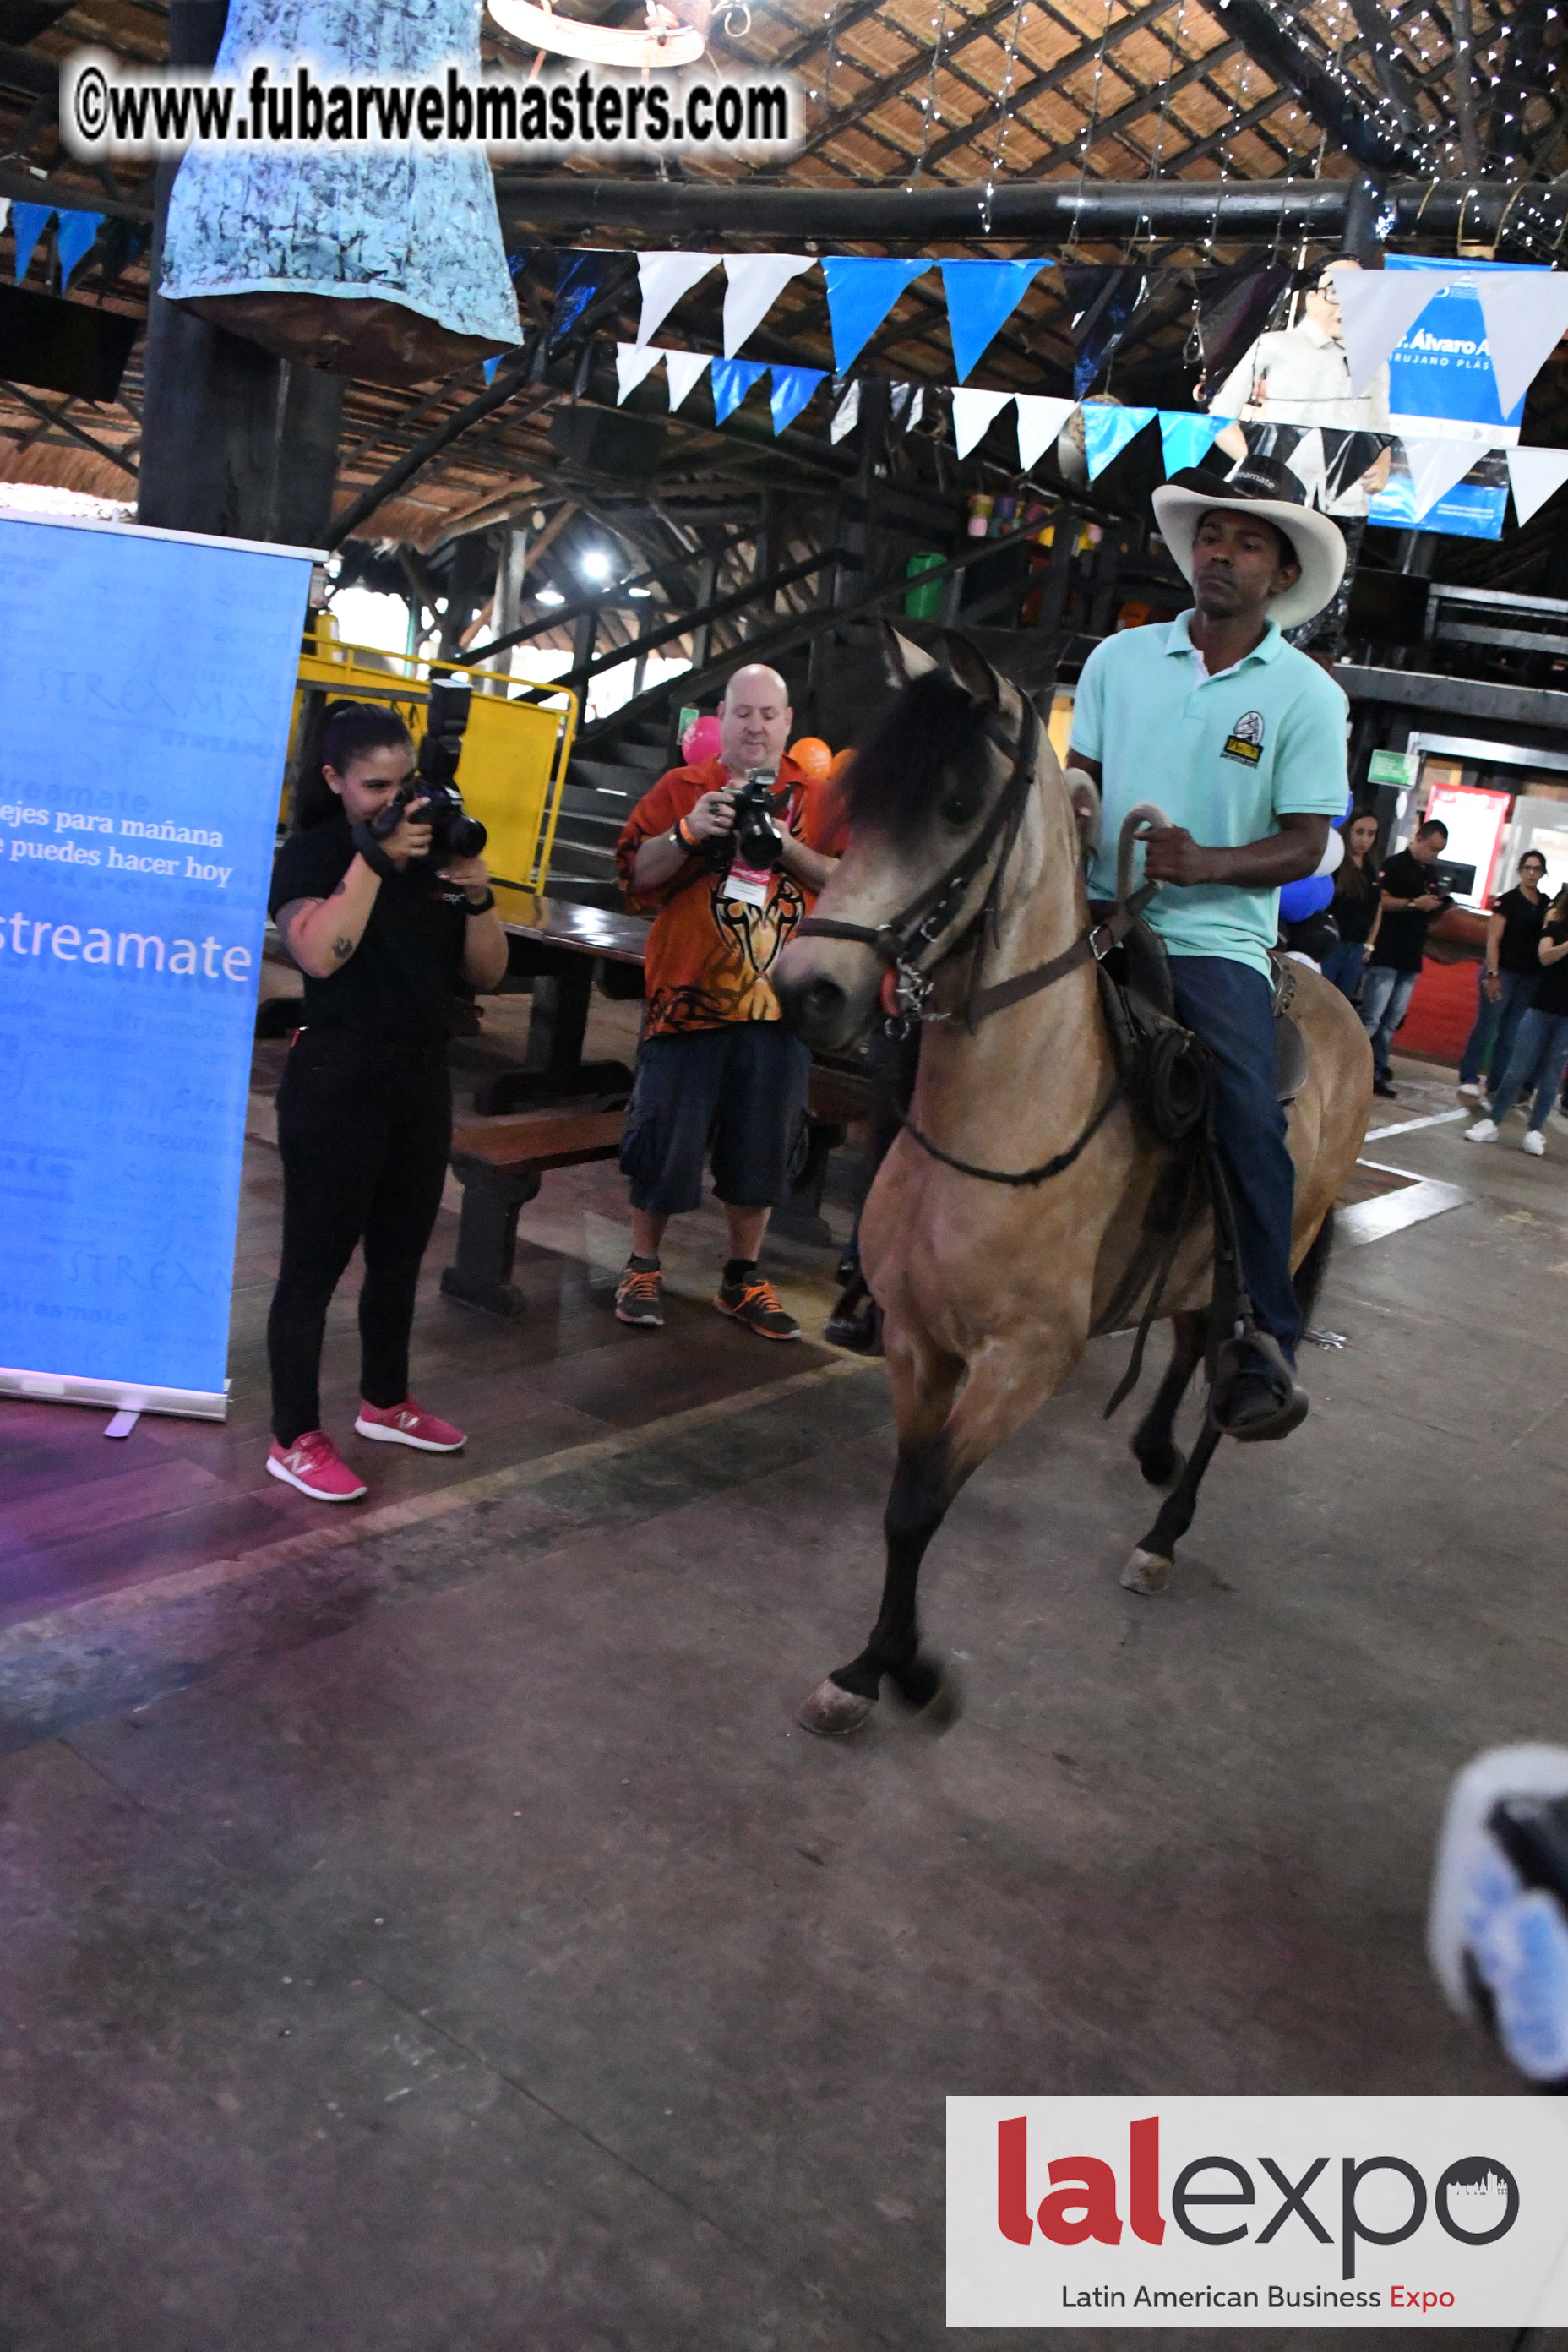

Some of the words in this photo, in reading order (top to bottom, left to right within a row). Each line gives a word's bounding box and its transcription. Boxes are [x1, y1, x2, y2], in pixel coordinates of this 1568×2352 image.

[54, 810, 114, 834] para
[120, 820, 225, 848] mañana
[9, 839, 101, 862] puedes
[106, 846, 181, 876] hacer
[184, 855, 234, 889] hoy
[0, 912, 253, 983] treamate
